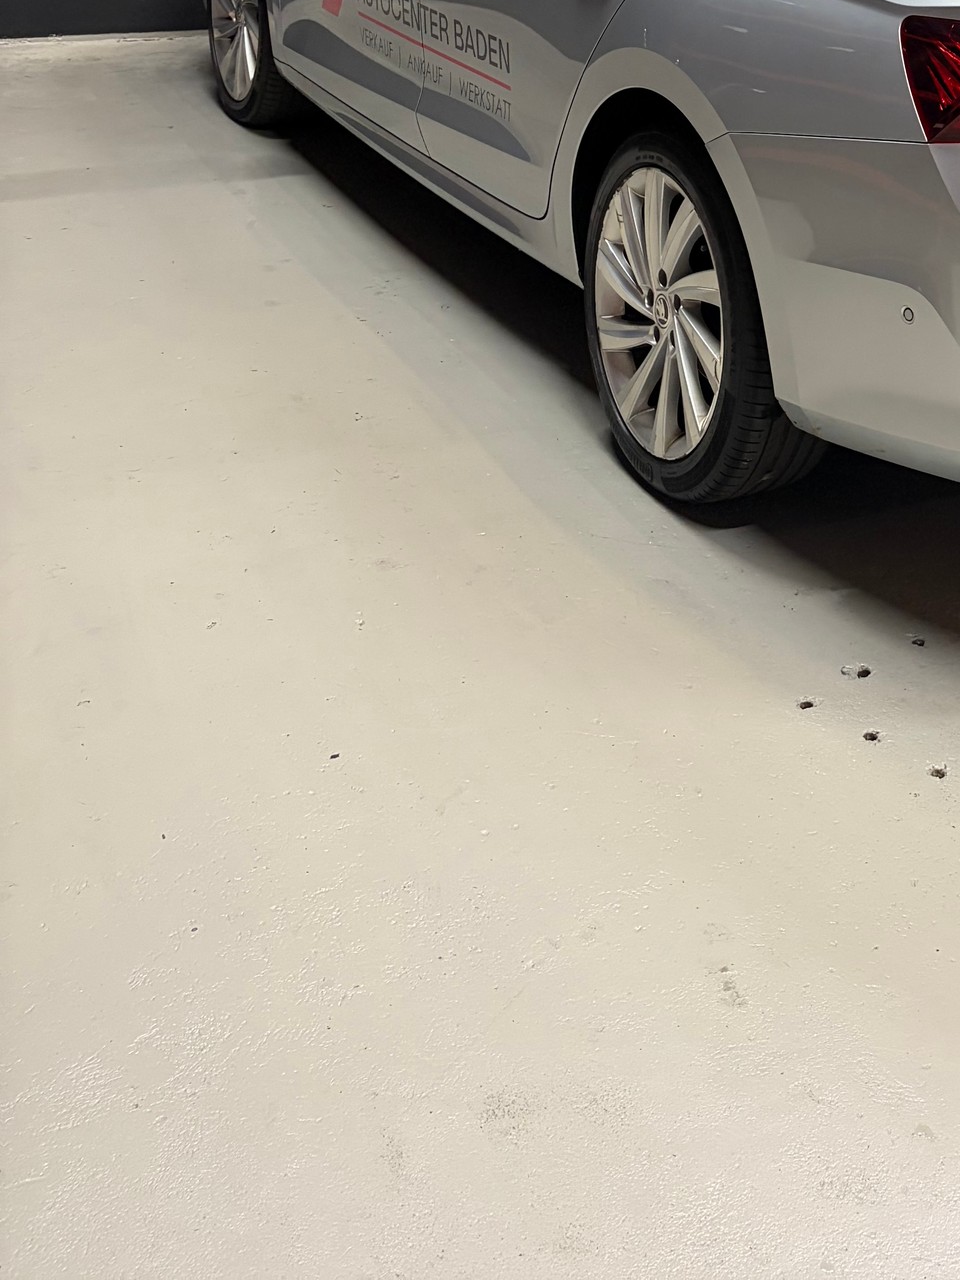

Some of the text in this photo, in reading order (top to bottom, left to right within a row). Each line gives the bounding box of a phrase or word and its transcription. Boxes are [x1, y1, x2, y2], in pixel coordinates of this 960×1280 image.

[360, 27, 512, 122] VERKAUF ANKAUF WERKSTATT
[454, 19, 511, 74] BADEN
